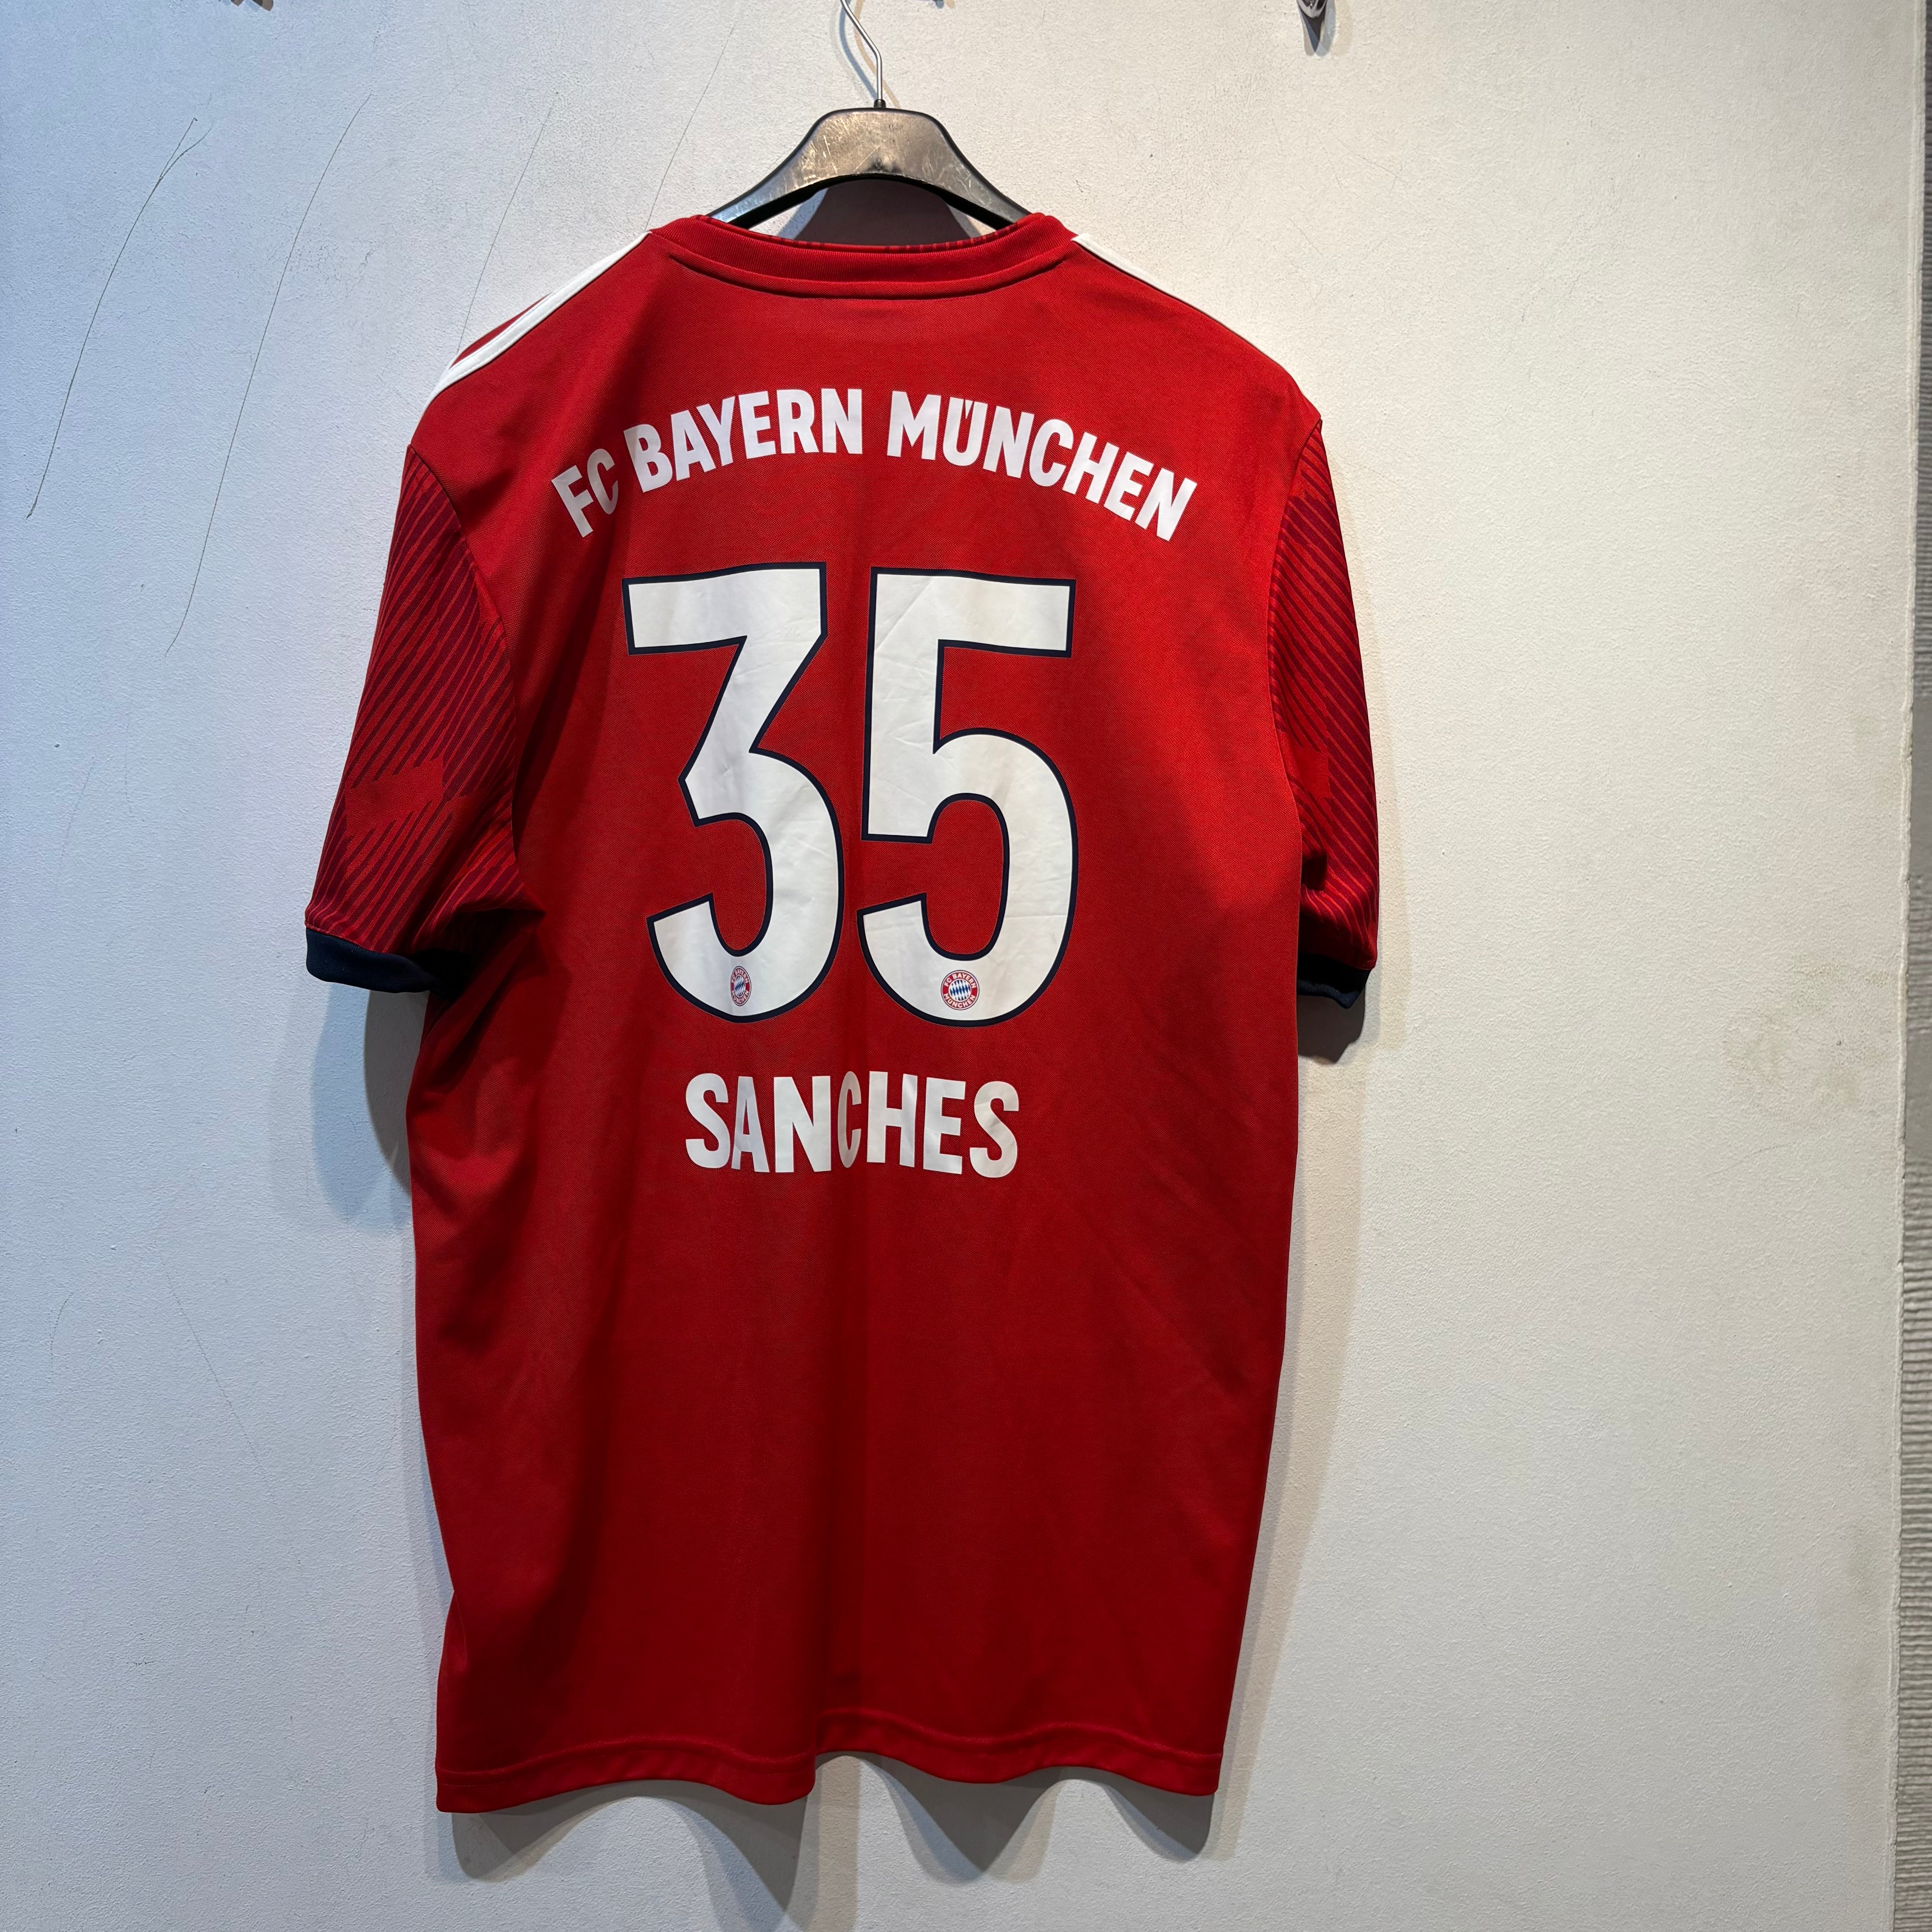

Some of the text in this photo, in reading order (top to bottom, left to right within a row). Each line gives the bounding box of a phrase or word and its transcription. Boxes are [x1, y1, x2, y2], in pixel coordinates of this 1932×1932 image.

[550, 387, 1198, 543] FC BAYERN MÜNCHEN
[622, 562, 1078, 1026] 35
[944, 973, 977, 989] FC BAYERN
[685, 1070, 1020, 1179] SANCHES
